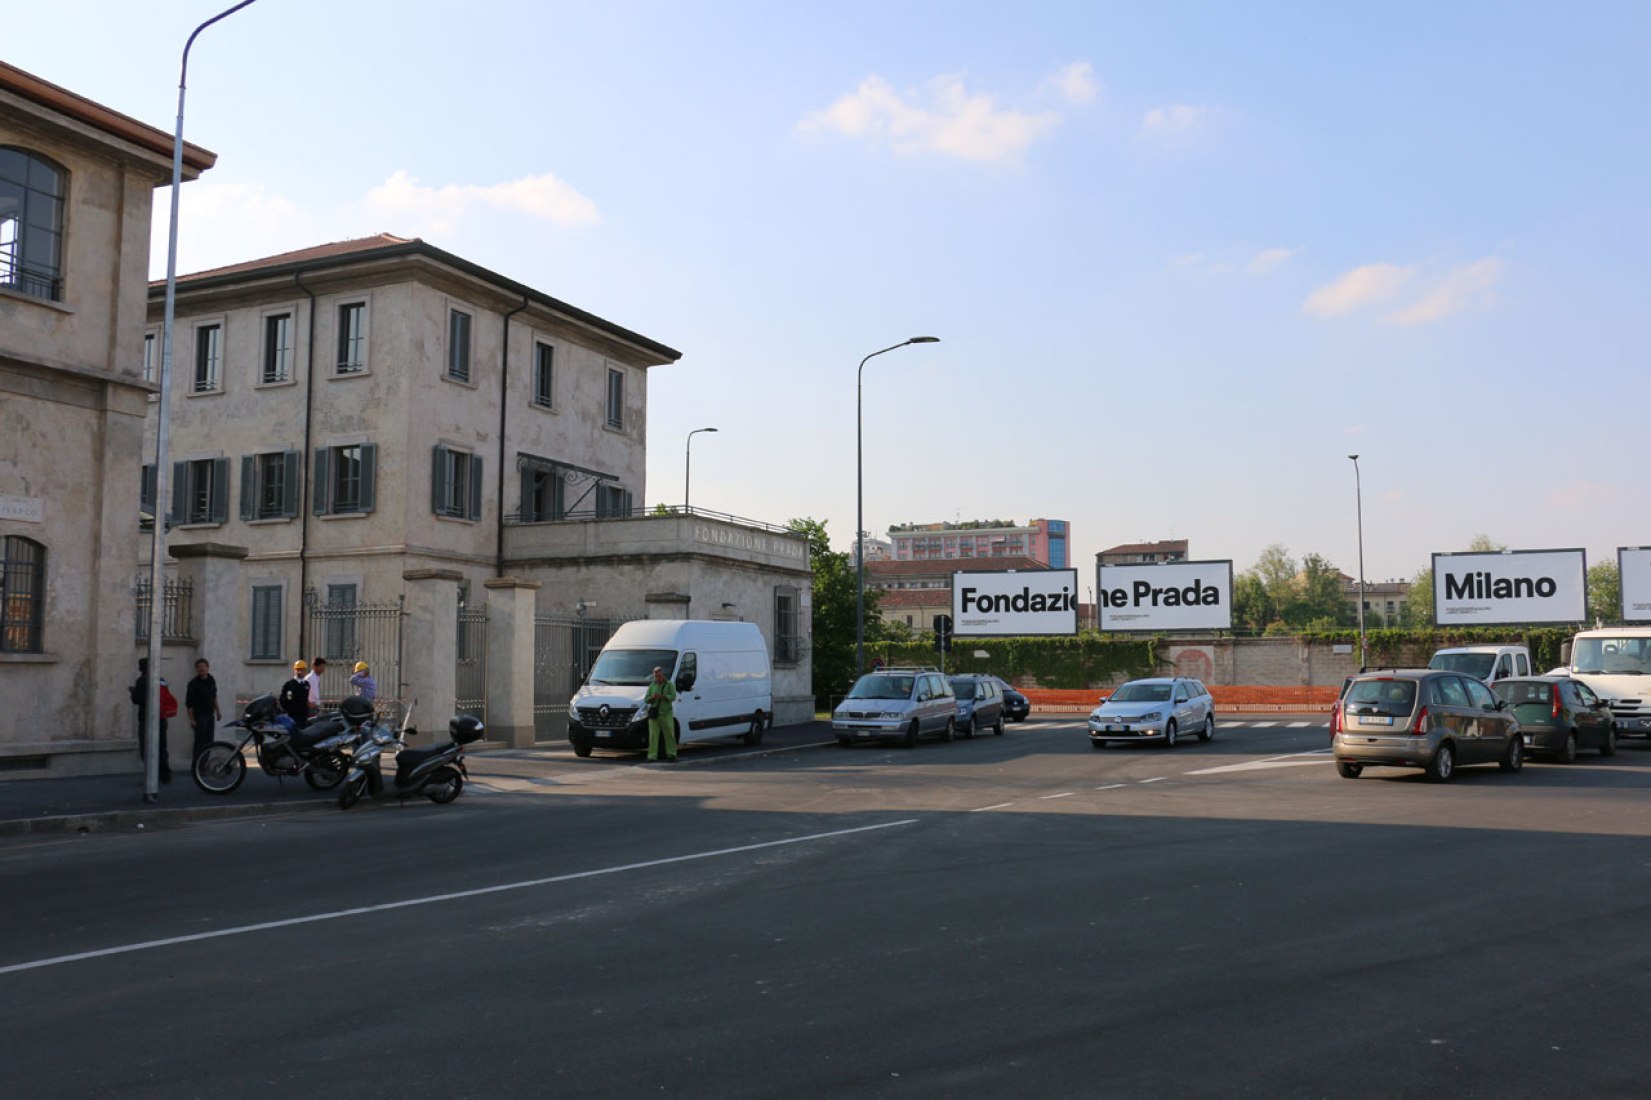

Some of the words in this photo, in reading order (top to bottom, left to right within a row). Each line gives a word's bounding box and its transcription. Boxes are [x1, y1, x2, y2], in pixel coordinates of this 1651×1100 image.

[694, 525, 766, 551] FONDAZIONE
[773, 541, 803, 556] PRADA
[1133, 578, 1220, 607] Prada
[1445, 571, 1557, 601] Milano
